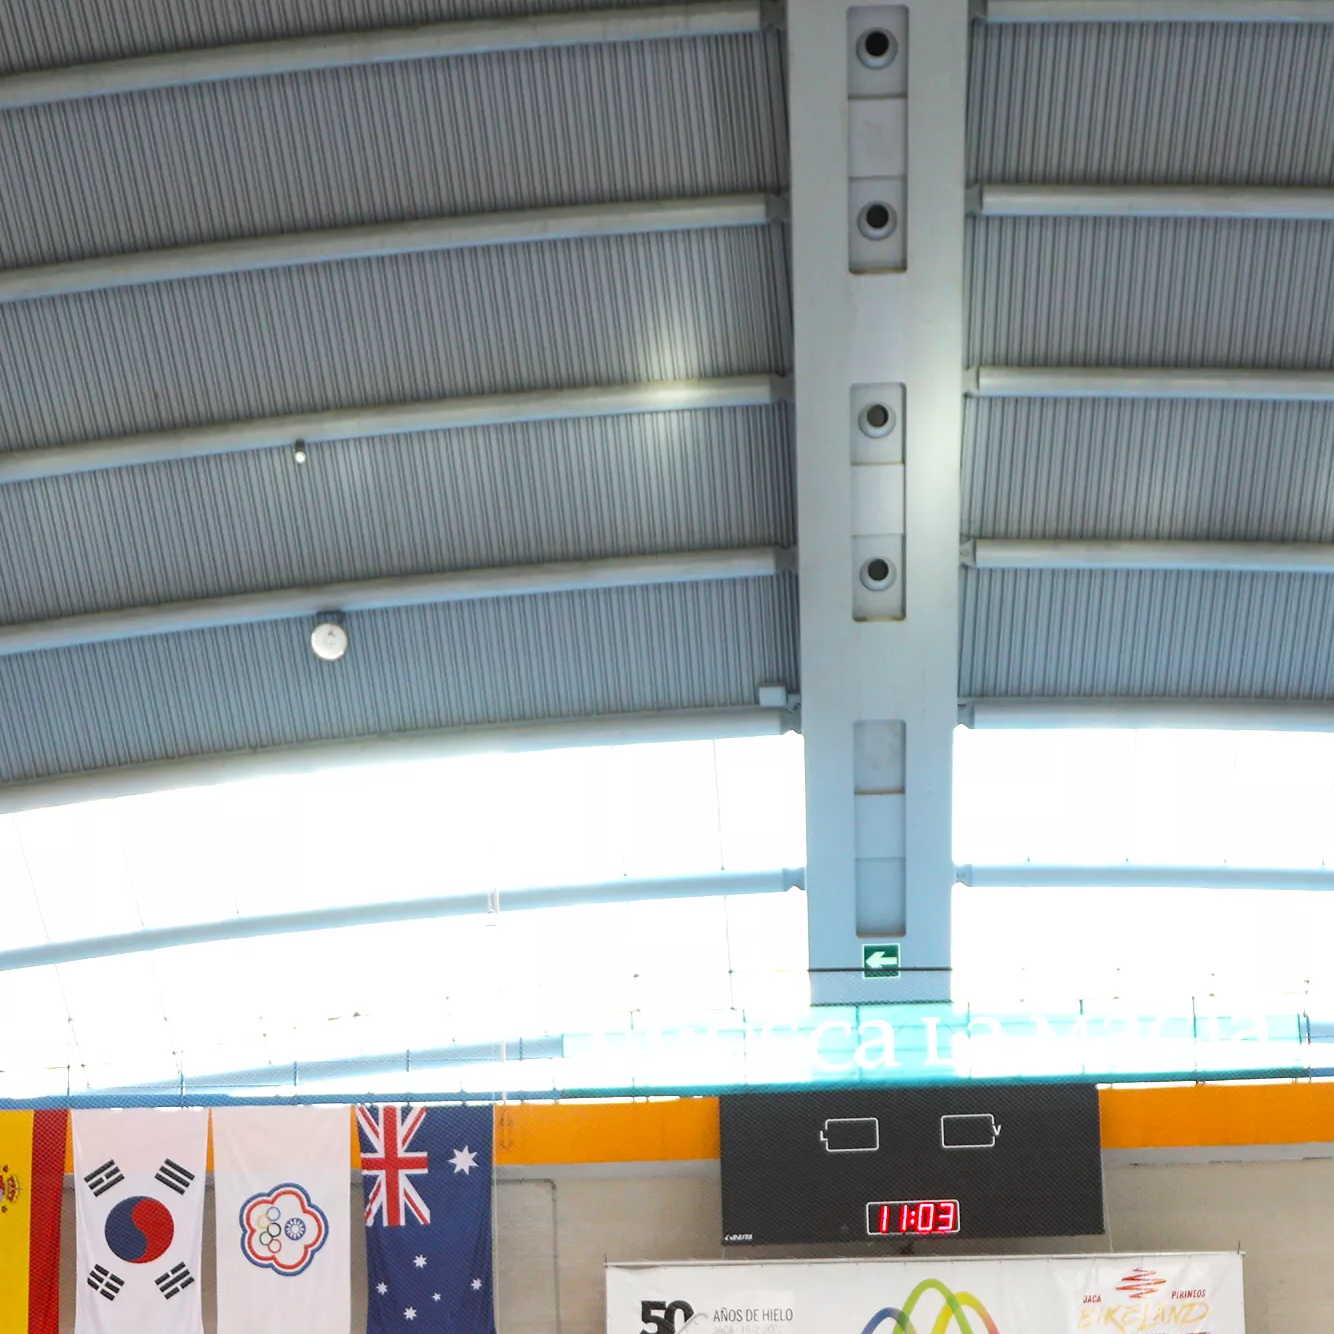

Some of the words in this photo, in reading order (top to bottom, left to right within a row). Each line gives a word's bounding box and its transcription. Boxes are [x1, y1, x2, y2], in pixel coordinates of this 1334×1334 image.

[820, 1130, 828, 1142] L
[992, 1124, 1002, 1136] V
[879, 1202, 957, 1233] 11:03
[1082, 1294, 1102, 1304] JACA
[713, 1307, 743, 1322] AÑOS
[746, 1308, 760, 1322] DE
[762, 1308, 794, 1322] HIELO
